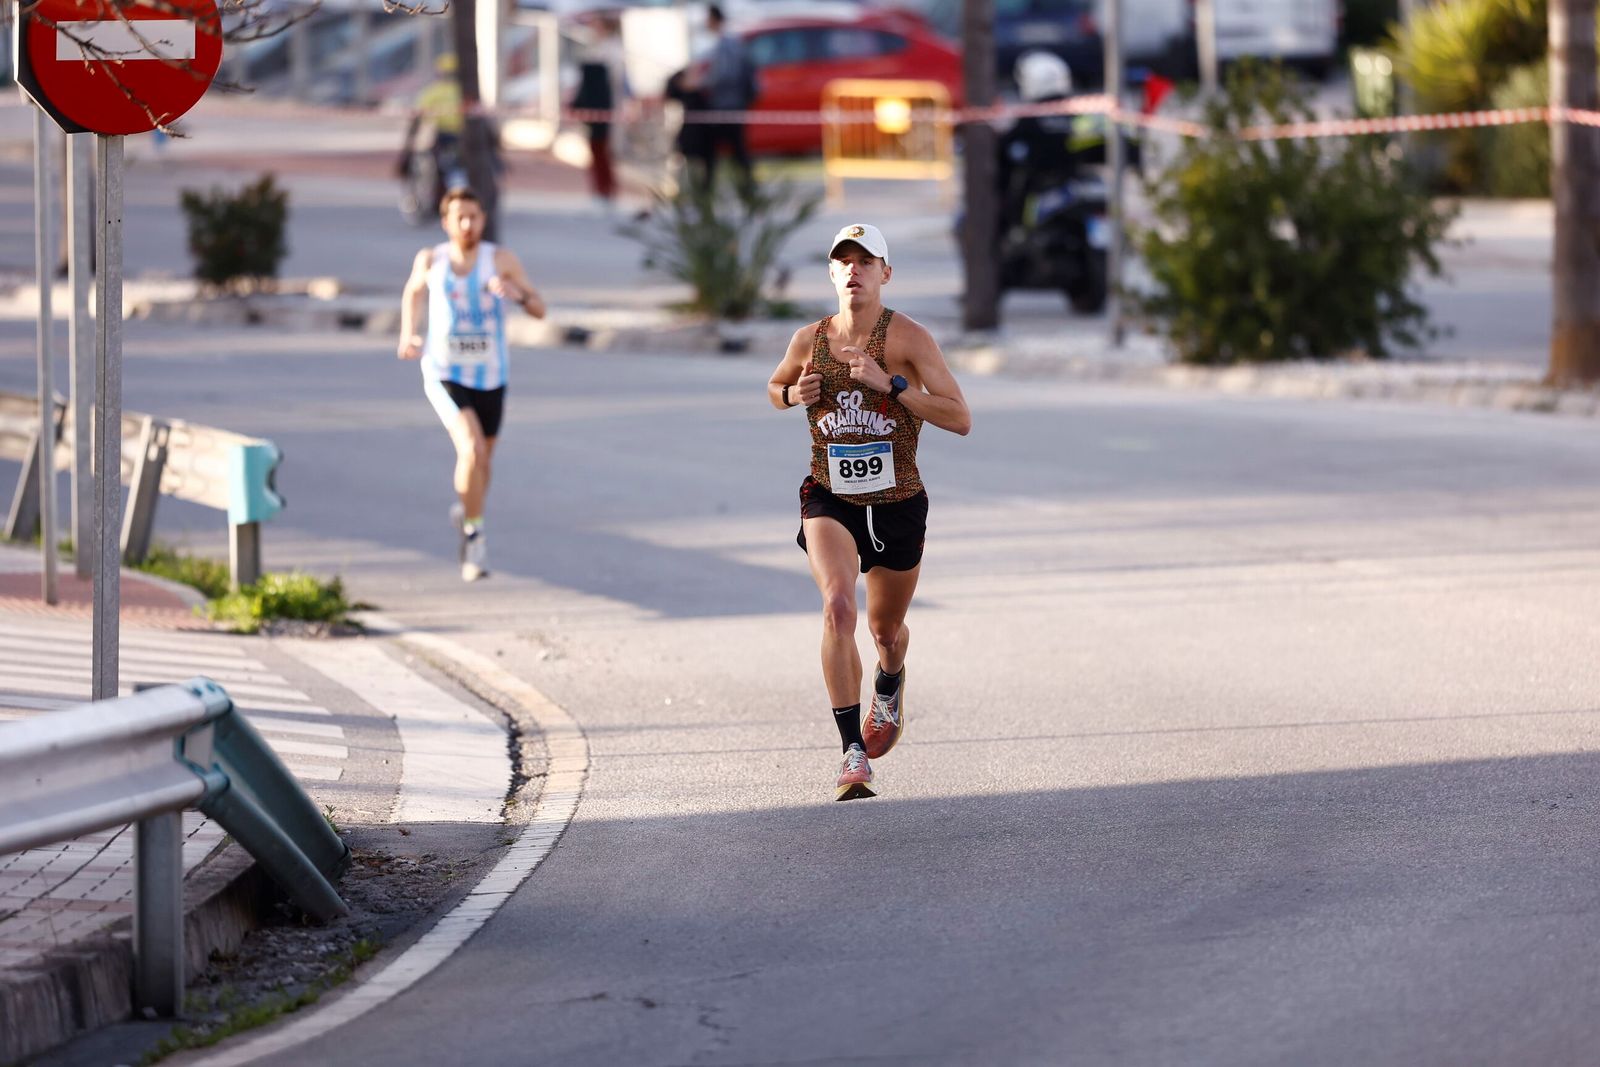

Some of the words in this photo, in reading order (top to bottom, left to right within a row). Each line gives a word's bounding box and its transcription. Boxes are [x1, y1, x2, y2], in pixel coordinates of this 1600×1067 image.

[837, 390, 863, 409] GO
[817, 408, 896, 436] TRAINING
[832, 426, 862, 438] running
[839, 456, 883, 478] 899
